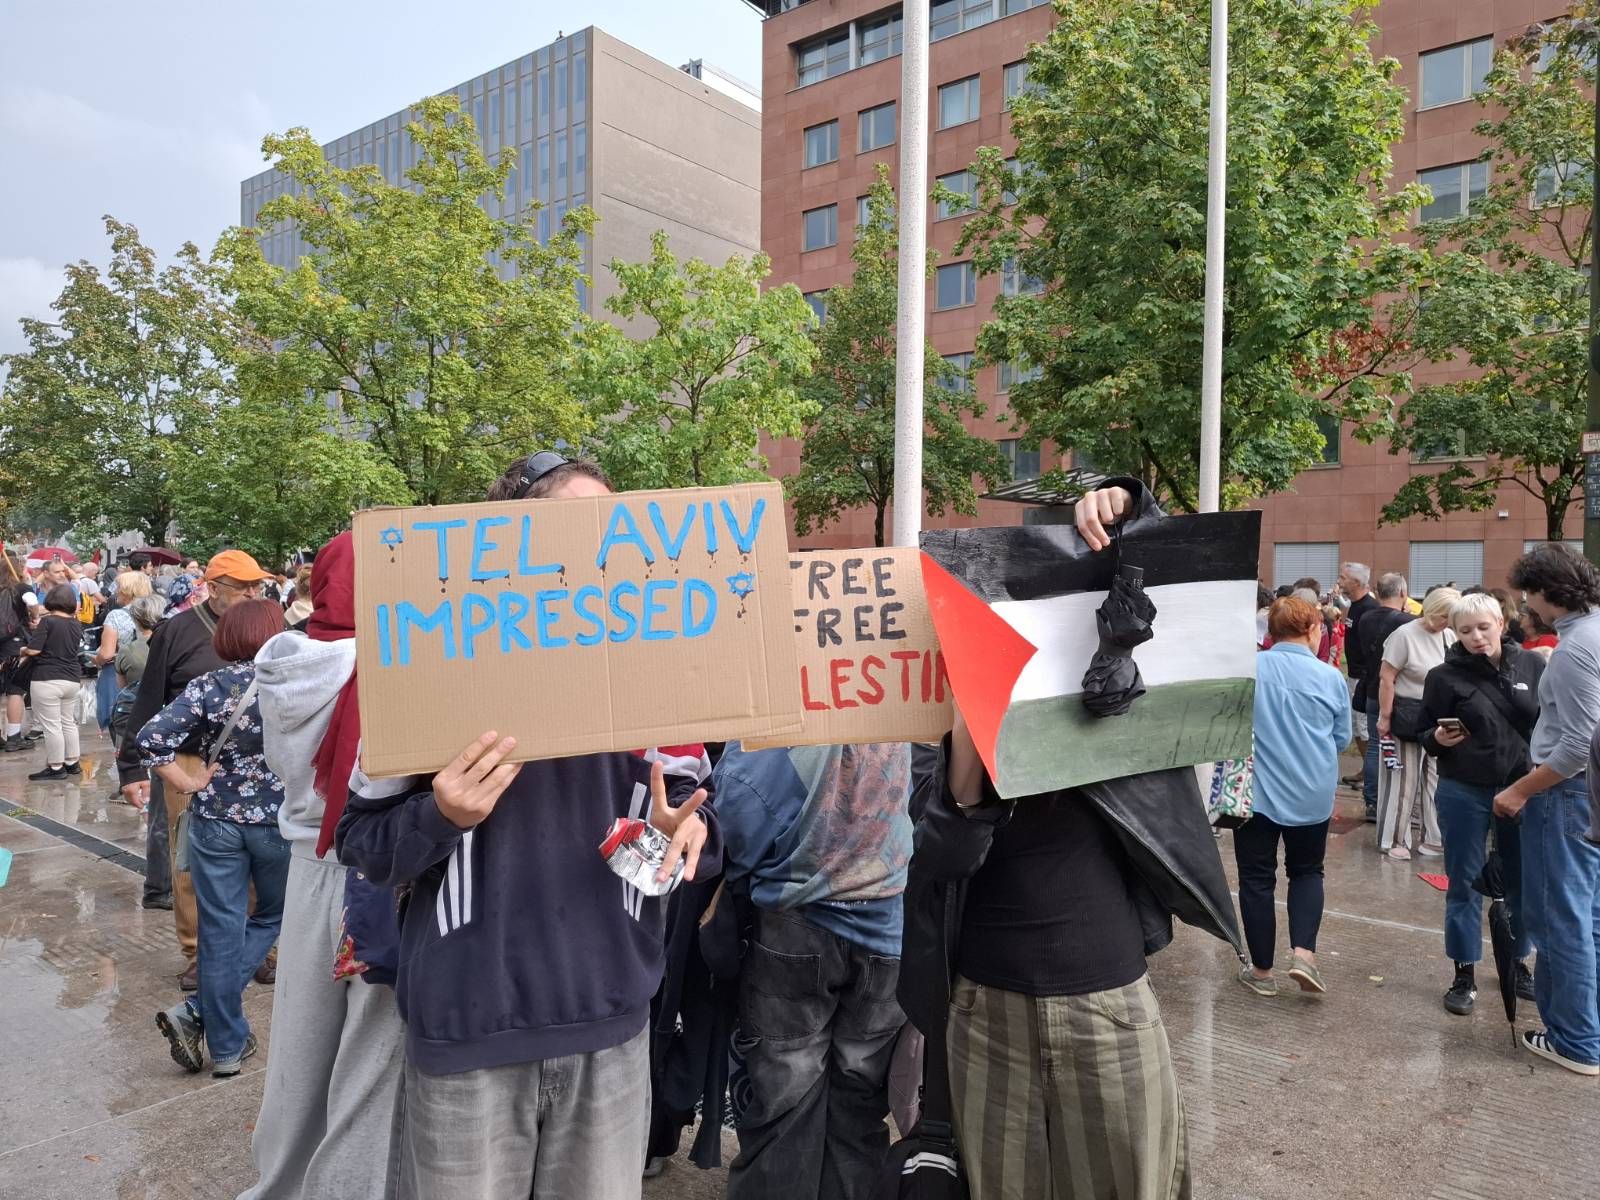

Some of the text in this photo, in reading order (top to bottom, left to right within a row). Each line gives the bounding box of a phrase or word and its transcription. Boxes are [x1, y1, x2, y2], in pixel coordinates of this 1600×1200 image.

[412, 498, 766, 581] TEL AVIV
[789, 557, 897, 600] REE
[377, 578, 717, 667] IMPRESSED
